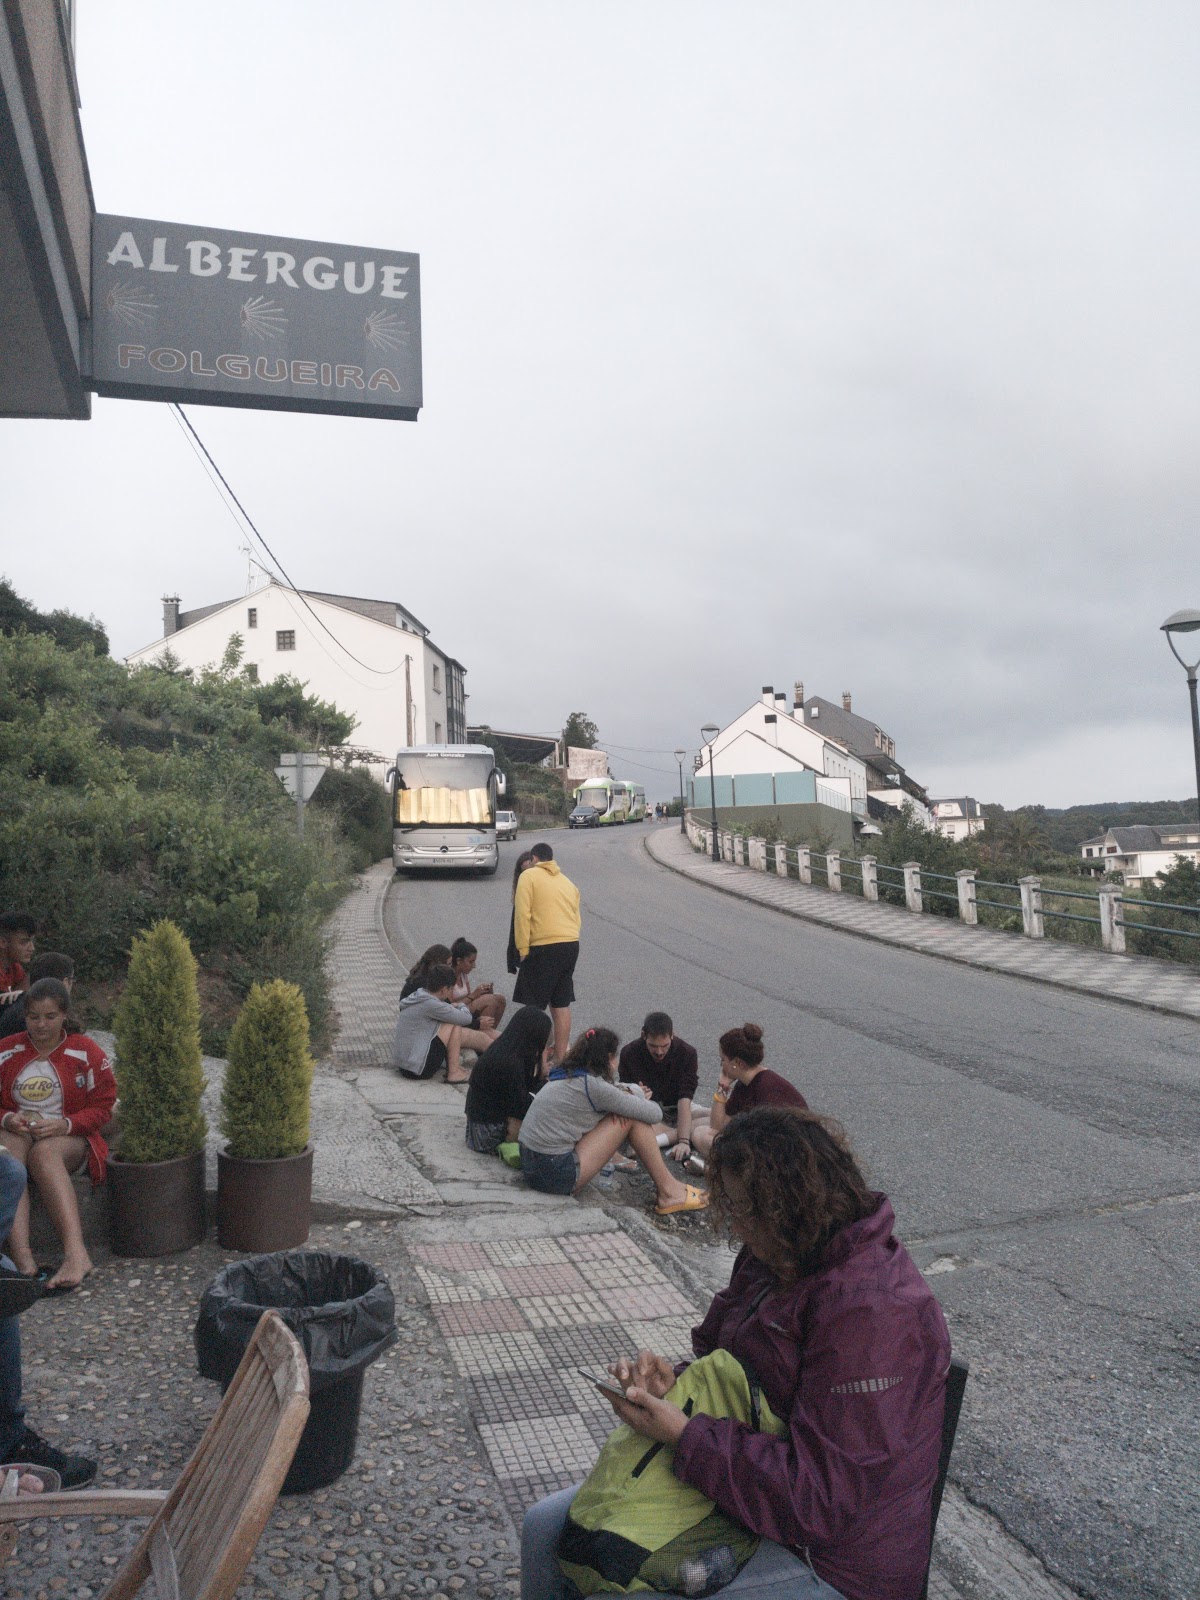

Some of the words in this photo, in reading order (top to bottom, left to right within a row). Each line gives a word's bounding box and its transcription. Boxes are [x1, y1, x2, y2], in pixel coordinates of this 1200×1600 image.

[106, 231, 410, 299] ALBERGUE
[117, 344, 401, 393] FOLGUEIRA
[38, 1080, 61, 1092] Roc
